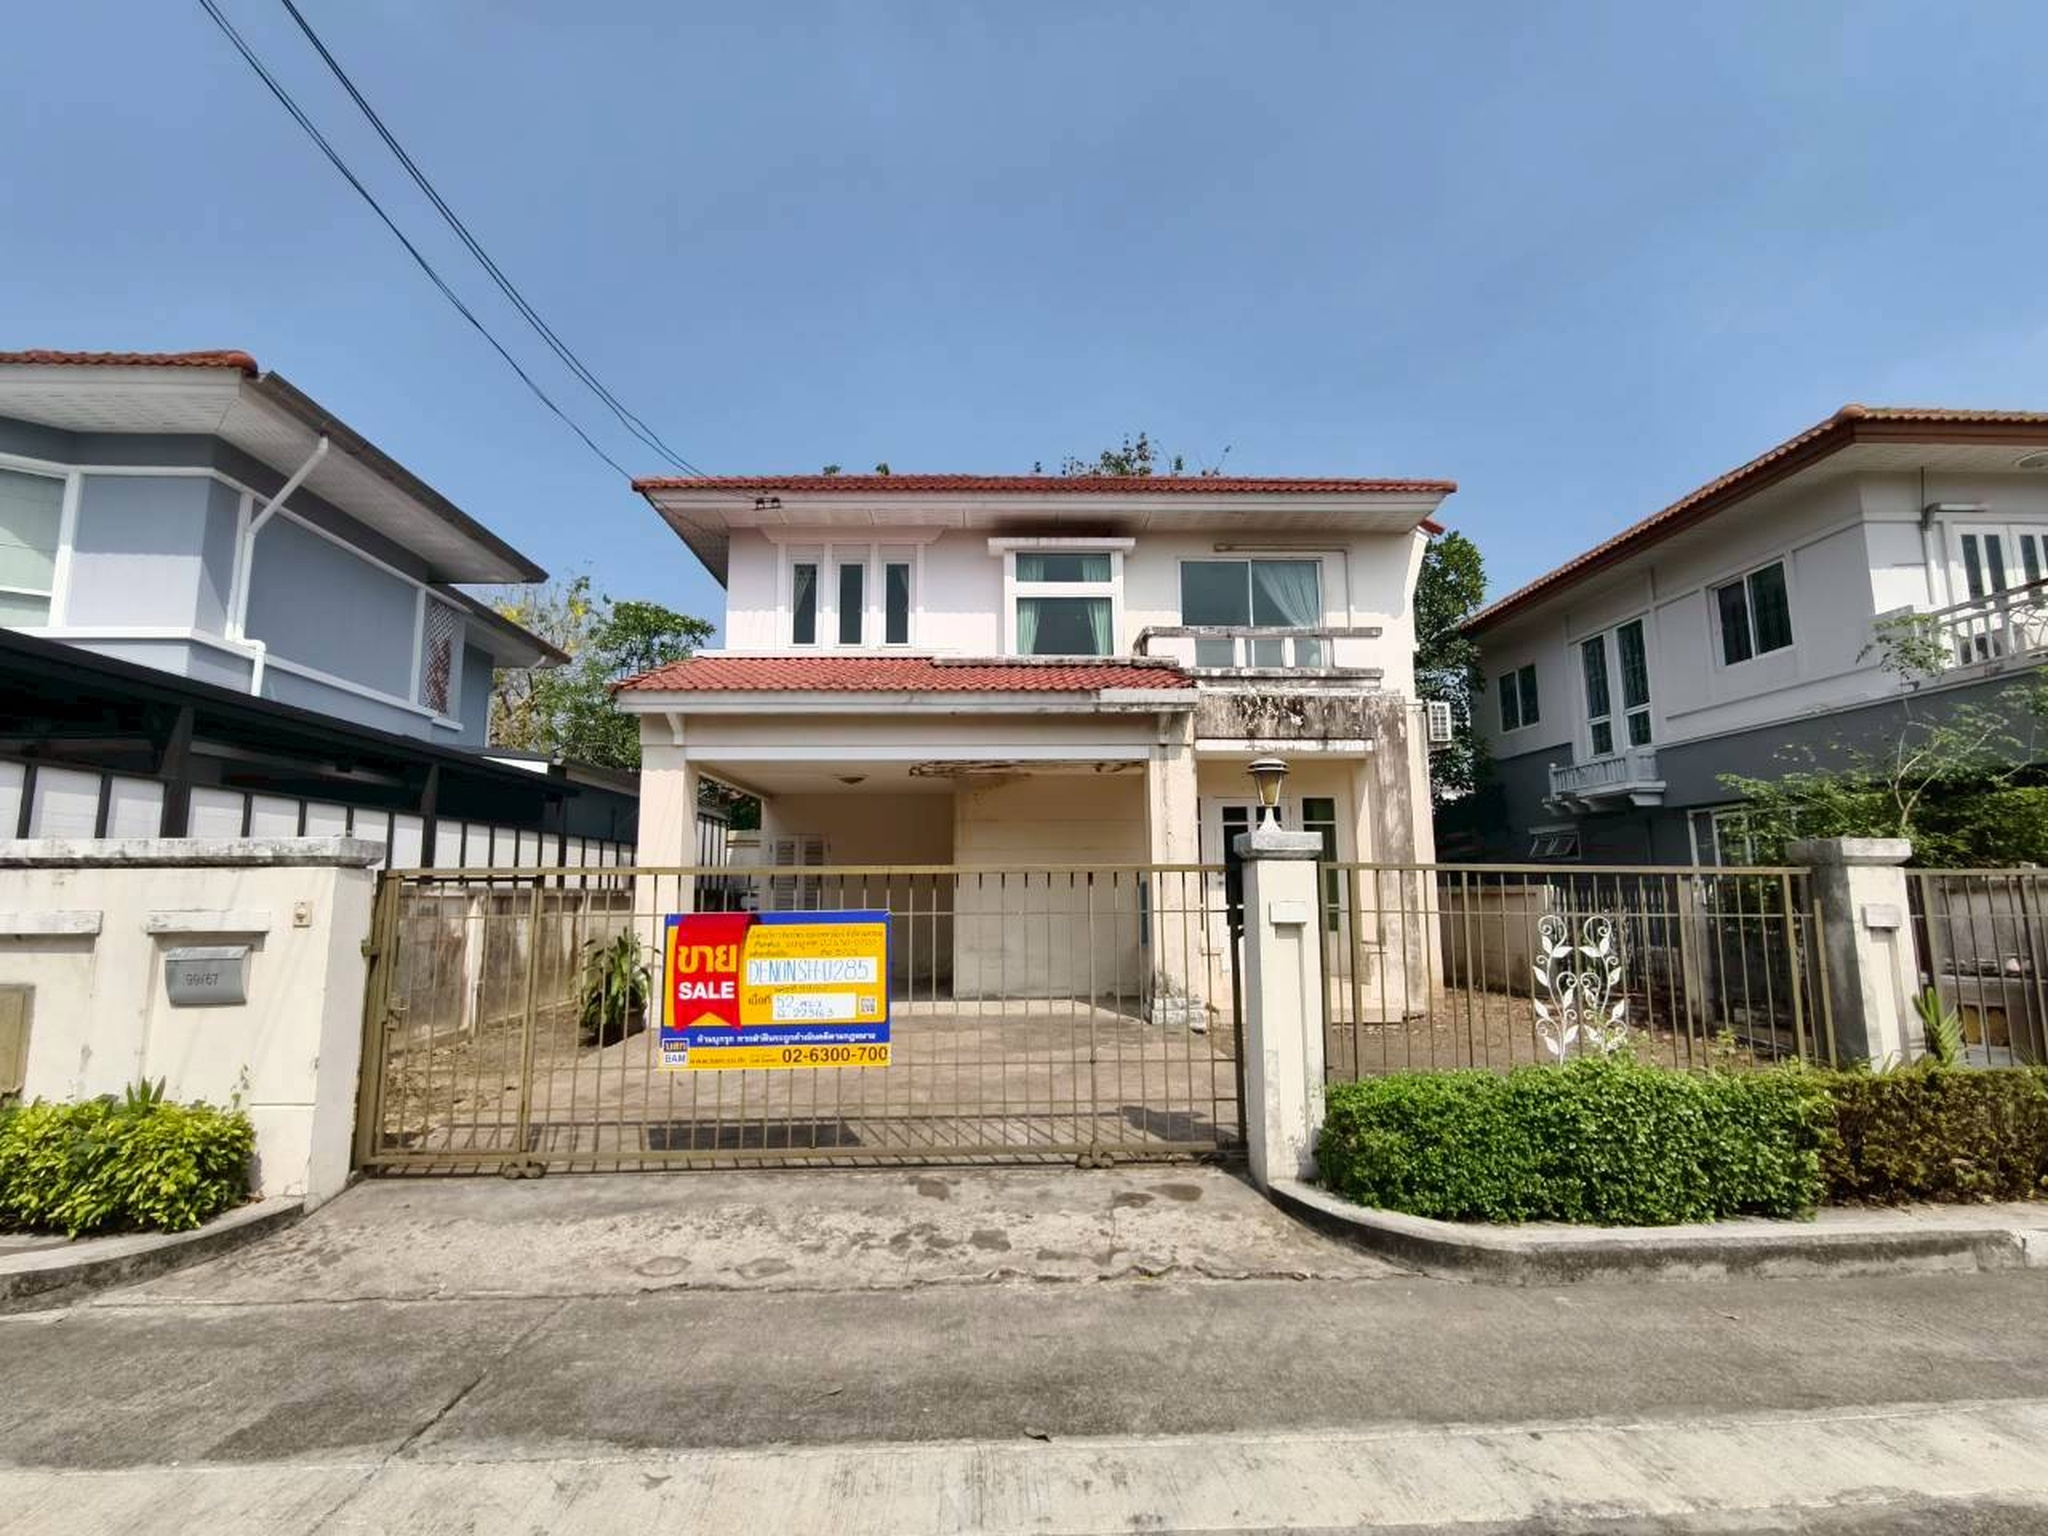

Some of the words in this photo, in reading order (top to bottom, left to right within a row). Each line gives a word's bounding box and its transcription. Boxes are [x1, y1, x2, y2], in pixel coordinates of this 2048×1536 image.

[678, 944, 738, 974] ขาย
[678, 981, 735, 1000] SALE
[665, 1054, 686, 1064] BAM
[782, 1045, 889, 1064] 02-6300-700
